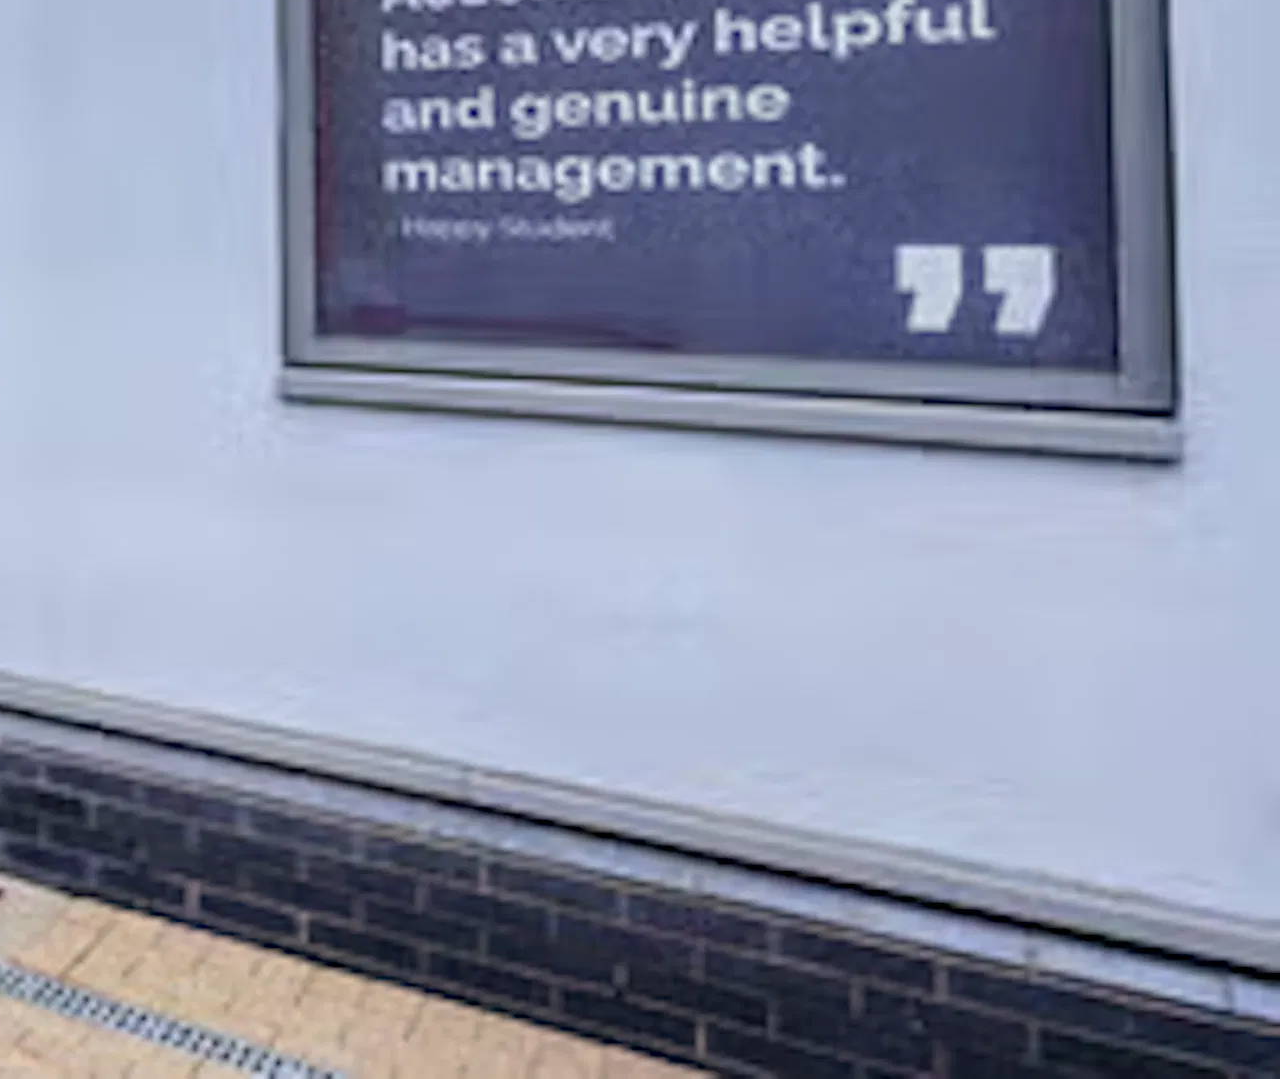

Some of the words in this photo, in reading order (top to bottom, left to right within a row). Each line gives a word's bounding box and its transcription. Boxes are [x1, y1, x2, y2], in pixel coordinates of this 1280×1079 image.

[380, 32, 486, 72] has
[498, 31, 539, 64] a
[553, 20, 699, 69] very
[381, 87, 496, 134] and
[509, 77, 792, 141] genuine
[381, 144, 848, 204] management.
